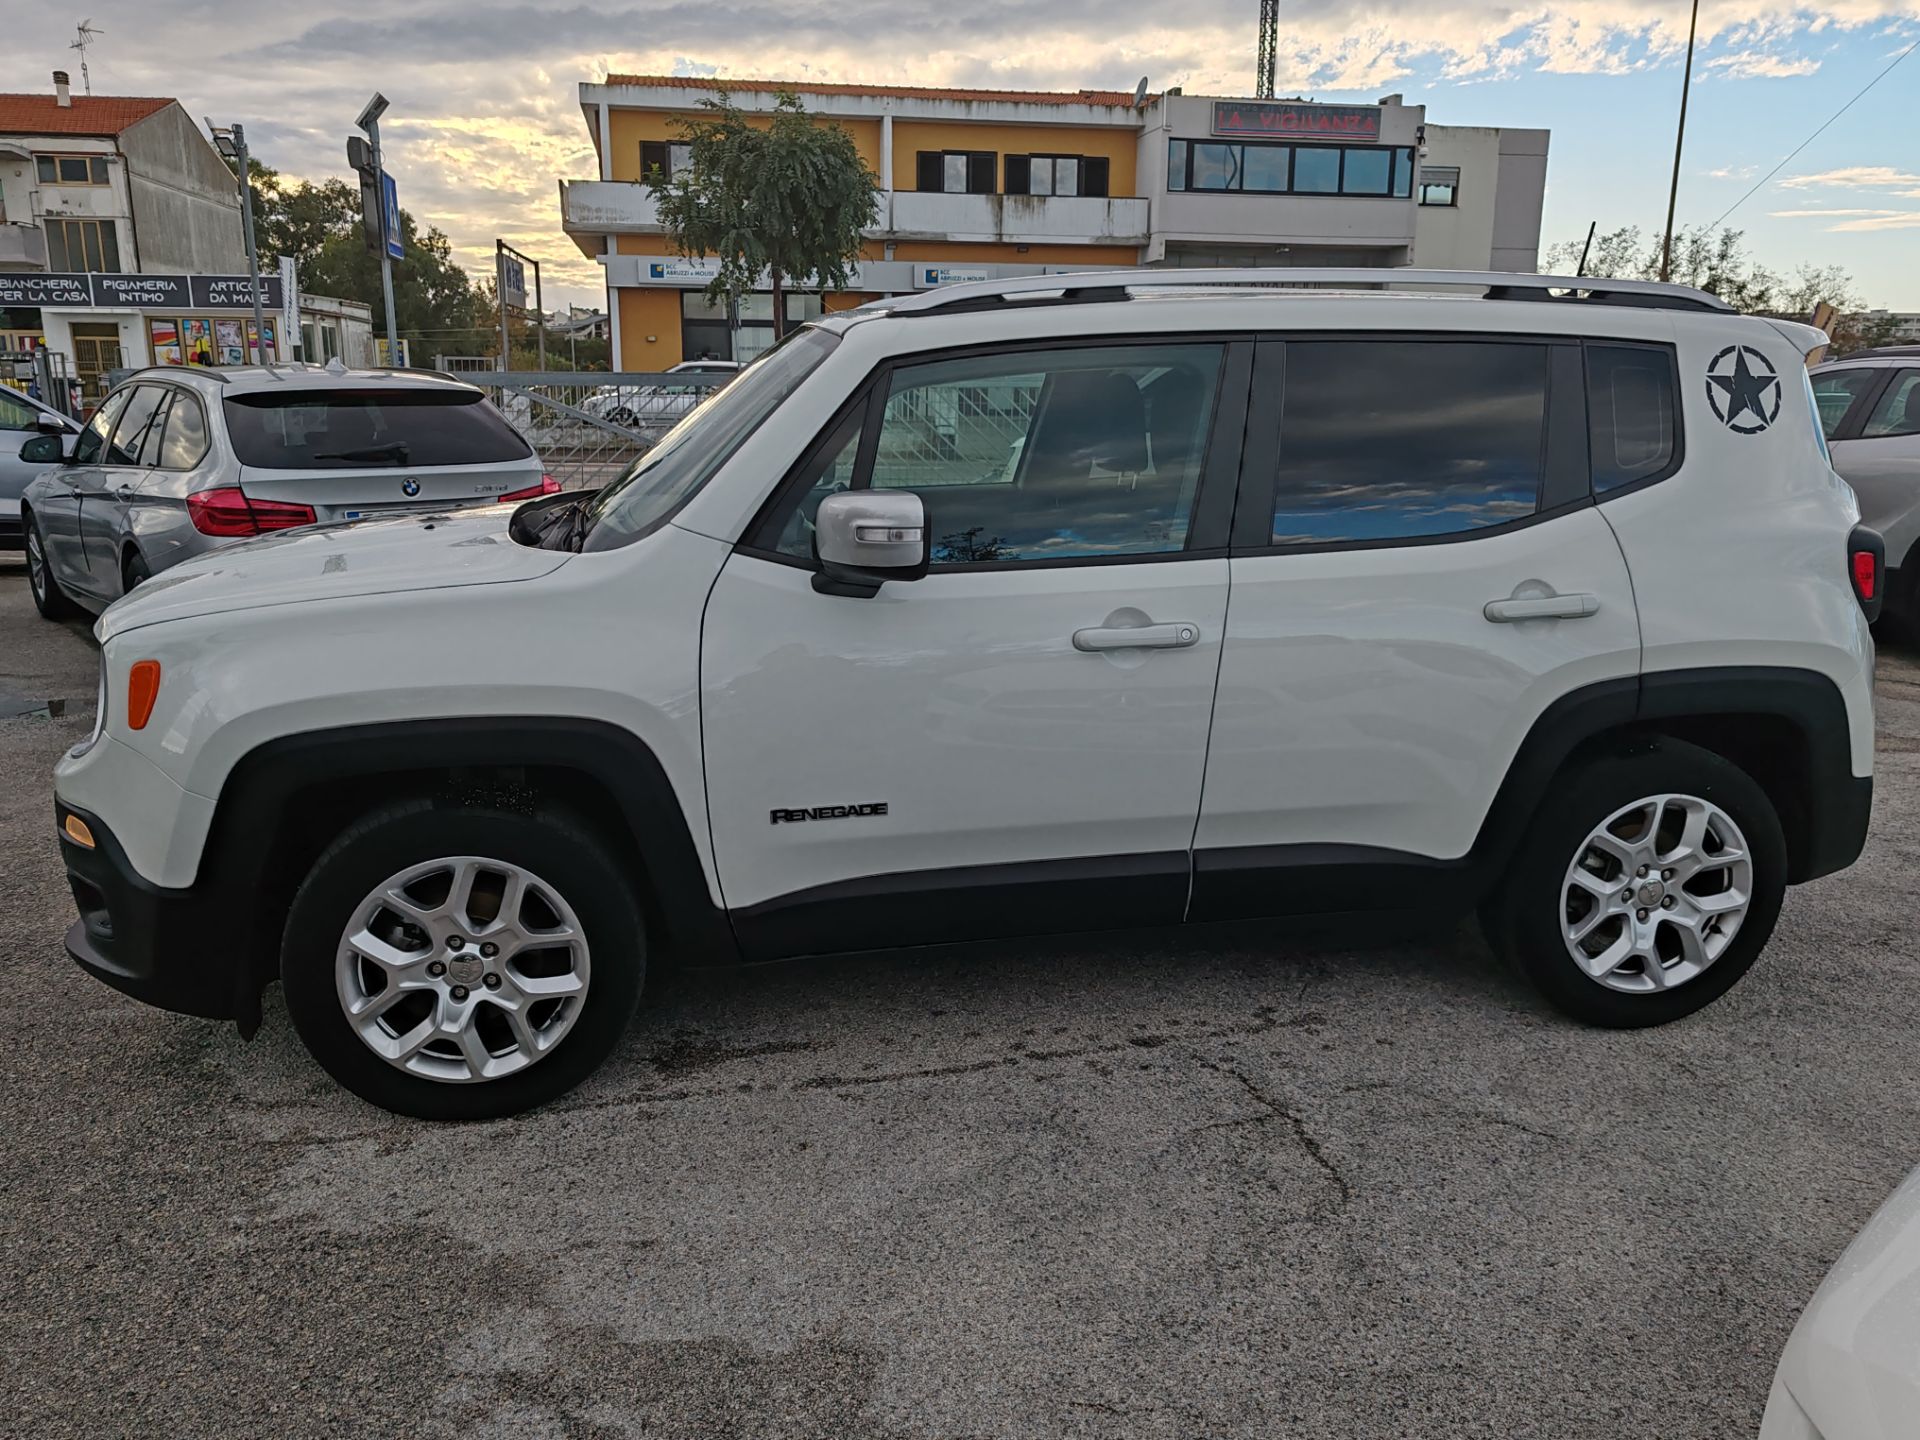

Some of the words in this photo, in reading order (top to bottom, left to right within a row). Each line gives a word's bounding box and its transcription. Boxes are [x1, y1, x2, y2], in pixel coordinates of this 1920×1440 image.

[1217, 111, 1243, 129] LA
[1260, 112, 1377, 132] VIGILANZA
[0, 279, 82, 290] BIANCHERIA
[102, 279, 178, 291] PIGIAMERIA
[28, 291, 47, 301] LA
[52, 291, 90, 302] CASA
[119, 291, 165, 303] INTIMO
[209, 293, 228, 304] DA
[232, 293, 271, 304] MAE
[770, 802, 888, 825] RENEGADE
